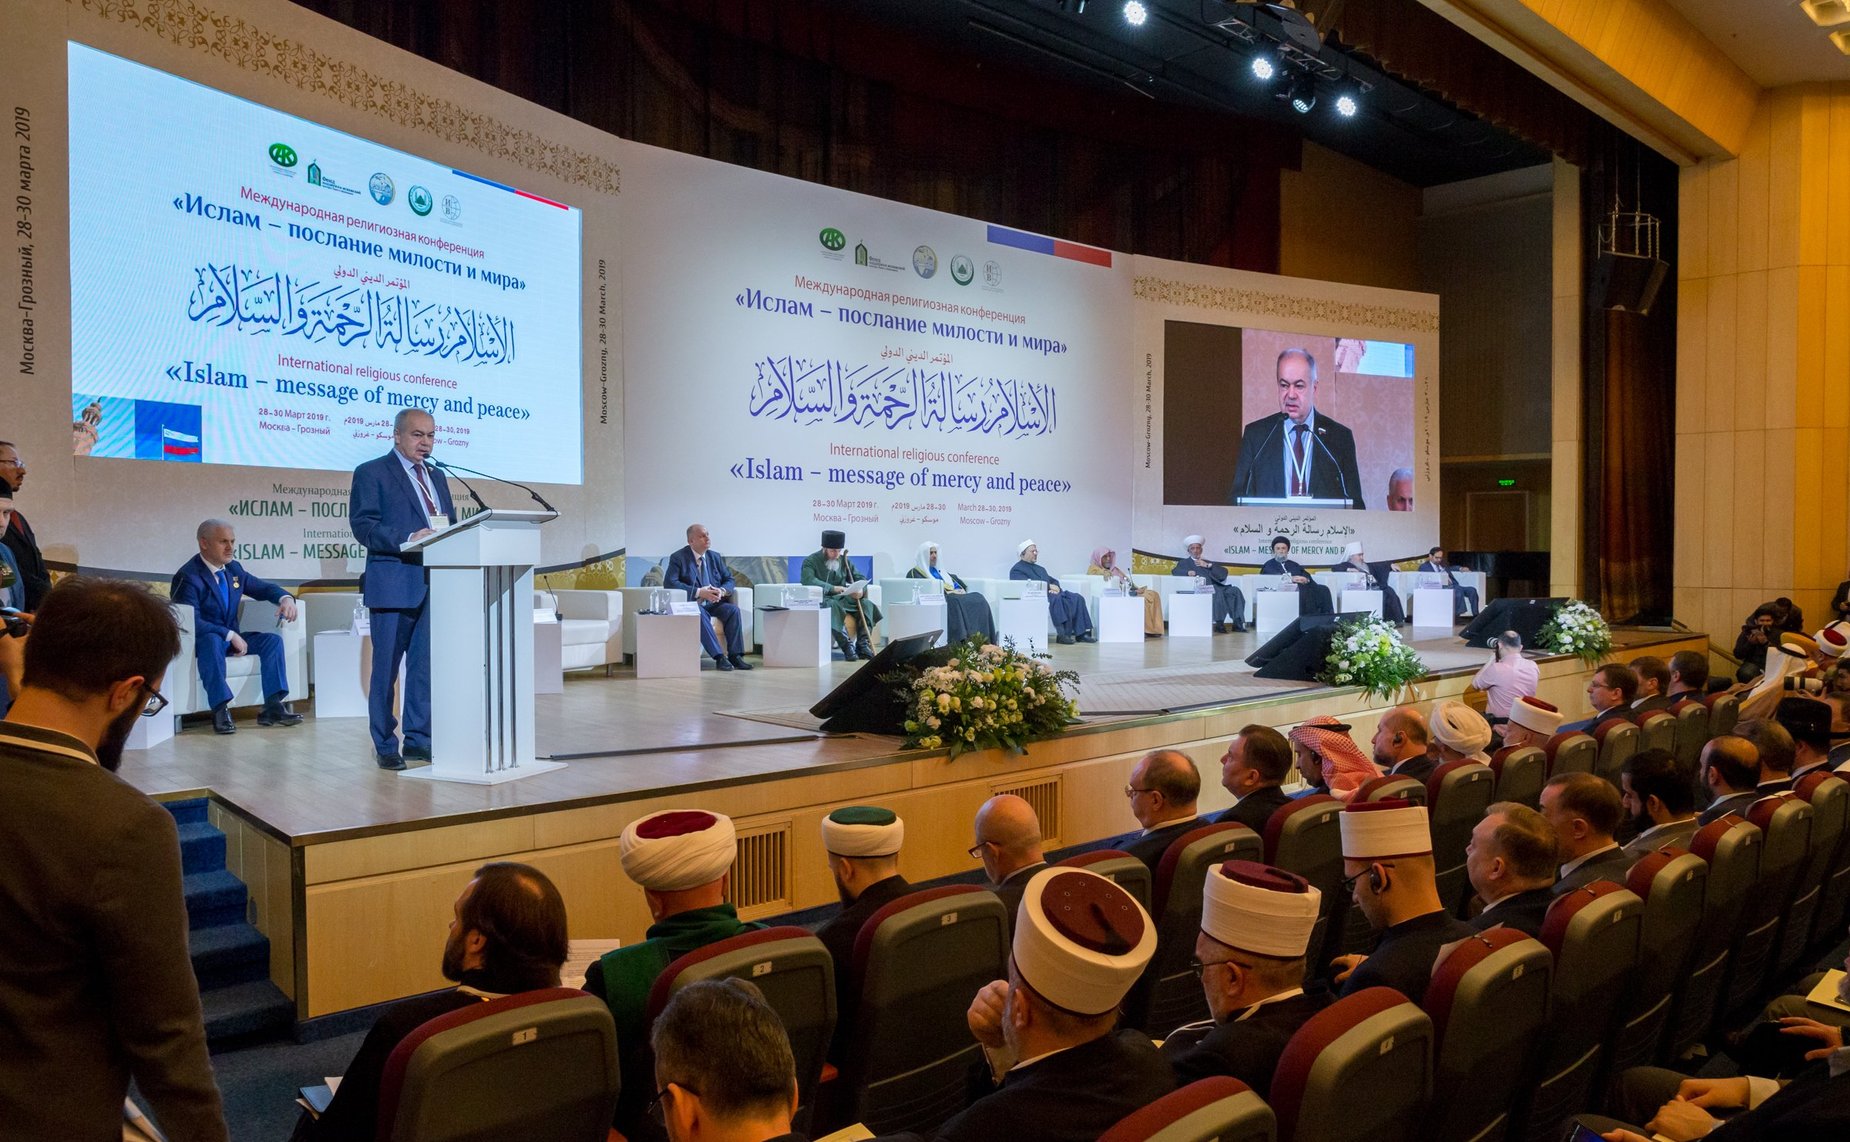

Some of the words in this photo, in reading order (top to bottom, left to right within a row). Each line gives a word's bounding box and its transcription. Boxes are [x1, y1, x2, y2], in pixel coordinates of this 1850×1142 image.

[14, 106, 31, 142] 2019
[19, 145, 35, 191] марта
[240, 186, 344, 224] Международная
[346, 216, 417, 242] религиозная
[418, 234, 485, 259] конференция
[172, 192, 262, 231] «Ислам
[288, 222, 383, 258] послание
[388, 247, 462, 276] милости
[466, 266, 476, 280] и
[481, 269, 526, 291] мира»
[598, 259, 607, 281] 2019
[794, 274, 890, 302] Международная
[892, 294, 958, 314] религиозная
[960, 306, 1026, 325] конференция
[736, 288, 814, 318] «Ислам
[838, 307, 927, 334] послание
[932, 322, 1003, 345] милости
[1008, 333, 1018, 348] и
[1022, 336, 1067, 356] мира»
[278, 354, 352, 376] International
[356, 366, 400, 382] religious
[404, 373, 458, 390] conference
[166, 360, 248, 389] «Islam
[276, 378, 358, 405] message
[364, 385, 384, 404] of
[387, 392, 440, 414] mercy
[444, 396, 474, 414] and
[478, 402, 530, 420] peace»
[284, 409, 306, 420] Март
[306, 412, 324, 421] 2019
[259, 420, 290, 432] Москва
[297, 424, 331, 436] Грозный
[456, 426, 470, 435] 2019
[447, 438, 469, 448] Grozny
[830, 442, 900, 460] International
[902, 448, 945, 464] religious
[948, 451, 1000, 466] conference
[730, 458, 804, 481] «Islam
[828, 468, 905, 490] message
[910, 466, 930, 486] of
[932, 473, 982, 494] mercy
[986, 472, 1016, 490] and
[1018, 477, 1072, 496] peace»
[228, 500, 293, 517] «ИСЛАМ
[836, 500, 856, 509] Март
[958, 504, 976, 512] March
[813, 514, 842, 523] Москва
[848, 513, 879, 523] Грозный
[960, 516, 986, 525] Moscow
[990, 517, 1011, 526] Grozny
[304, 527, 352, 539] Internatio
[304, 544, 366, 560] MESSAGE
[1224, 546, 1250, 554] «ISLAM
[1291, 546, 1299, 554] OF
[1302, 546, 1323, 554] MERCY
[1325, 546, 1338, 555] AND
[523, 1032, 527, 1040] 1
